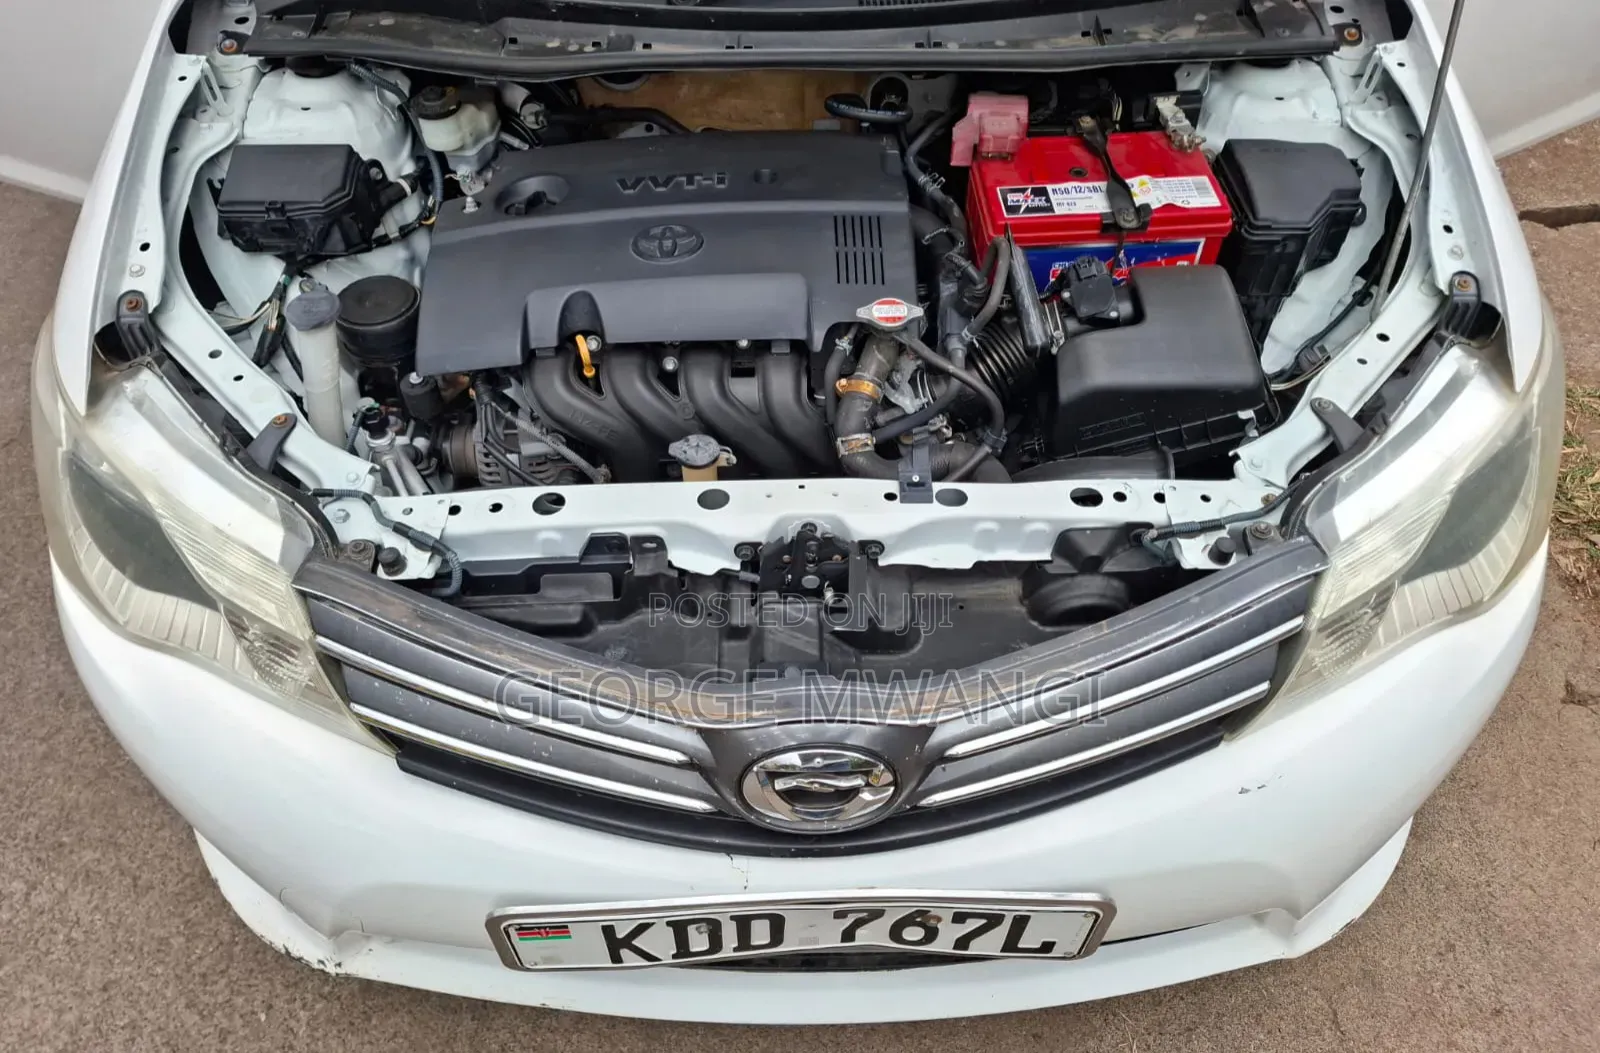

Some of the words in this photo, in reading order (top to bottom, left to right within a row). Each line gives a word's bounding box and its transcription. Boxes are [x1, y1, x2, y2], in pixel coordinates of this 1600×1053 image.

[615, 172, 728, 193] VVT-i
[601, 912, 786, 964] KDD
[832, 909, 1057, 954] 767L
